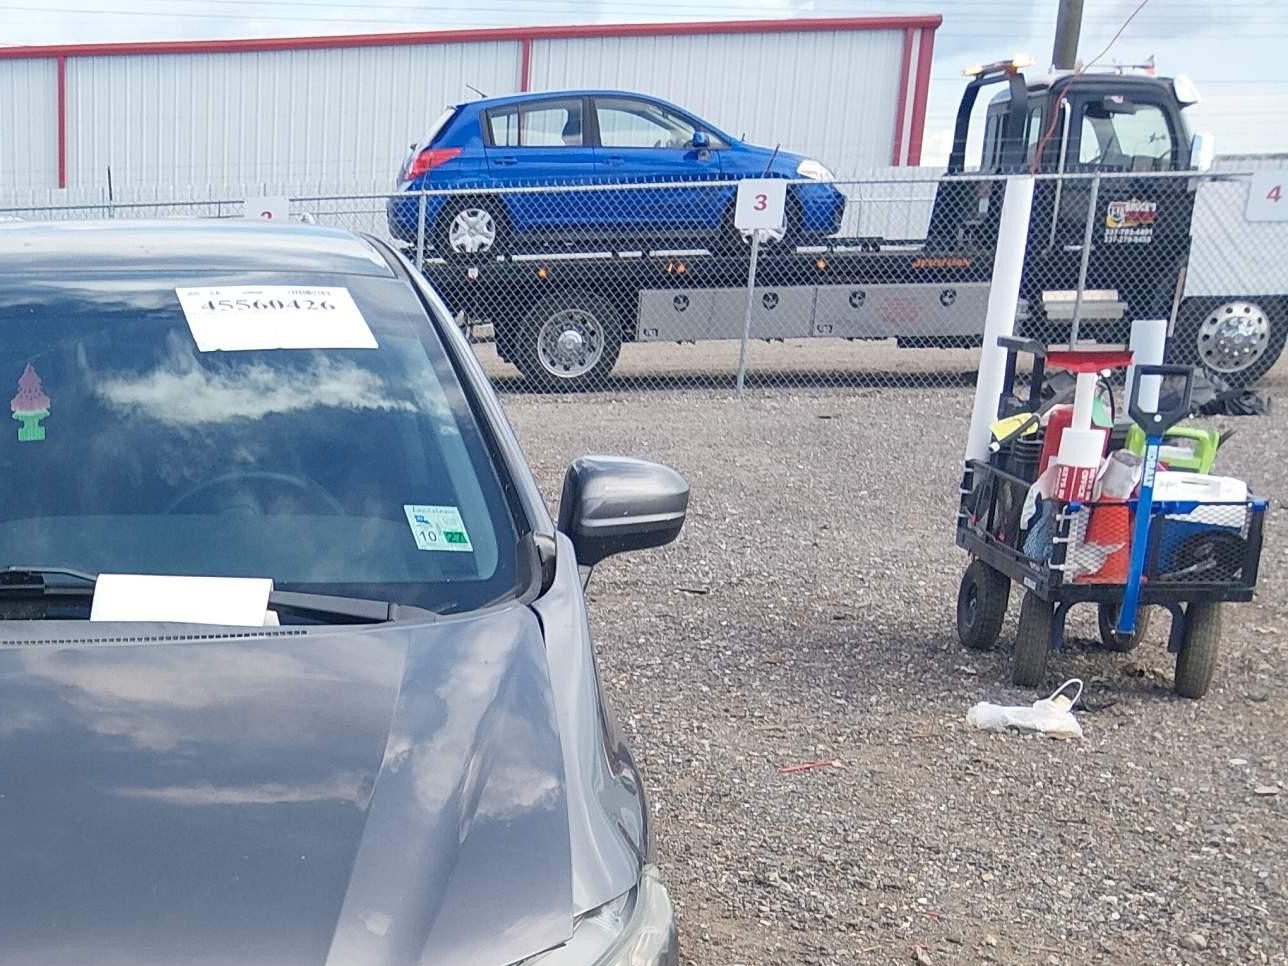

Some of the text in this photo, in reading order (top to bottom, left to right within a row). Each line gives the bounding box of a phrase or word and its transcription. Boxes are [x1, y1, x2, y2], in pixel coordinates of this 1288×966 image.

[1266, 185, 1282, 203] 4
[753, 194, 767, 211] 3
[201, 299, 336, 312] 45560426
[420, 530, 438, 542] 10
